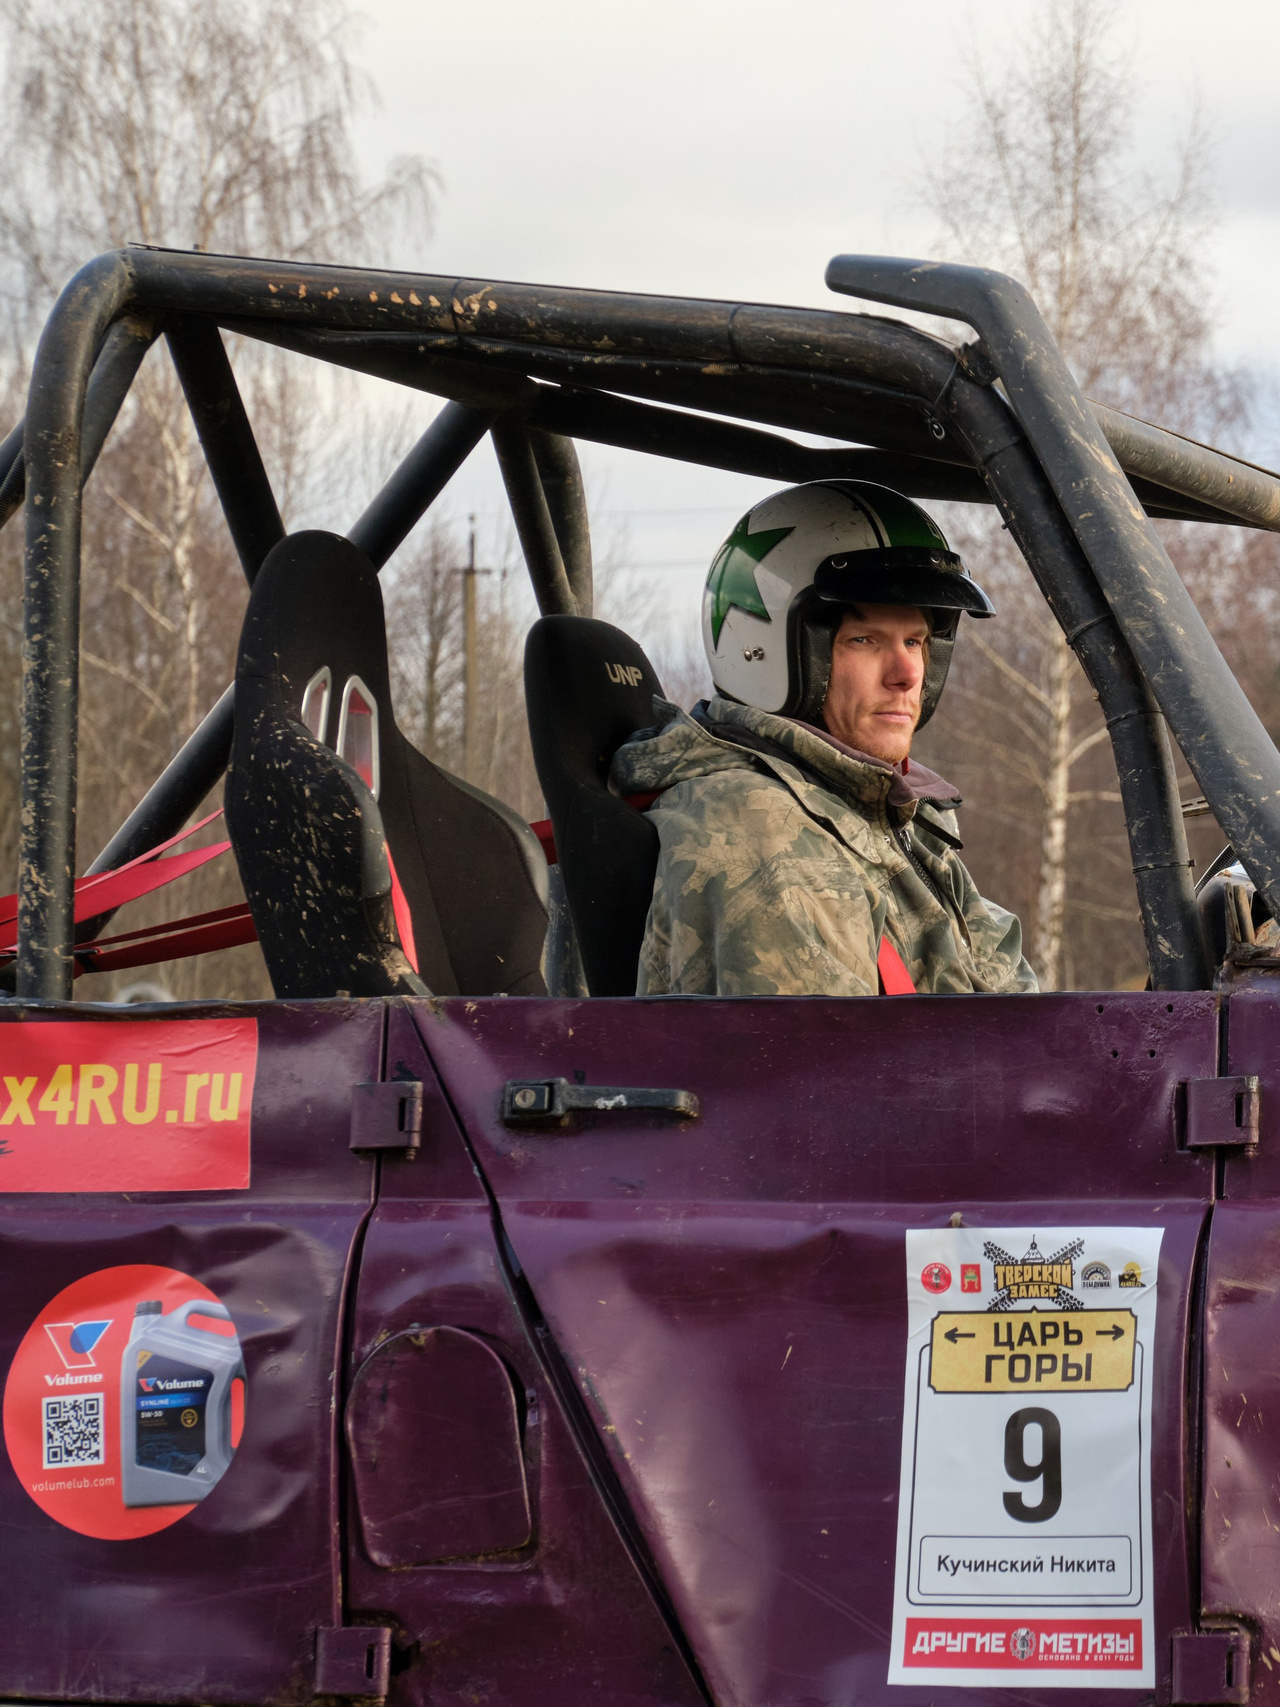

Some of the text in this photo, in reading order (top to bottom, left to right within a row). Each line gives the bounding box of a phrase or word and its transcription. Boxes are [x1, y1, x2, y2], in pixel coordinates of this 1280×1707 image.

[604, 661, 643, 687] UNP
[0, 1063, 243, 1126] x4RU.ru
[994, 1256, 1073, 1292] ТВЕРСКОЙ
[1009, 1284, 1059, 1299] ЗАМЕС
[993, 1320, 1083, 1351] ЦАРЬ
[43, 1372, 103, 1387] Volume
[984, 1352, 1092, 1384] ГОРЫ
[156, 1378, 205, 1390] Volume
[140, 1398, 169, 1407] SYNLINE
[1002, 1406, 1062, 1524] 9
[31, 1476, 115, 1492] volumelub.com
[937, 1554, 1116, 1577] Кучинский Никита
[912, 1631, 1134, 1655] ДРУГИЕ МЕТИЗЫ
